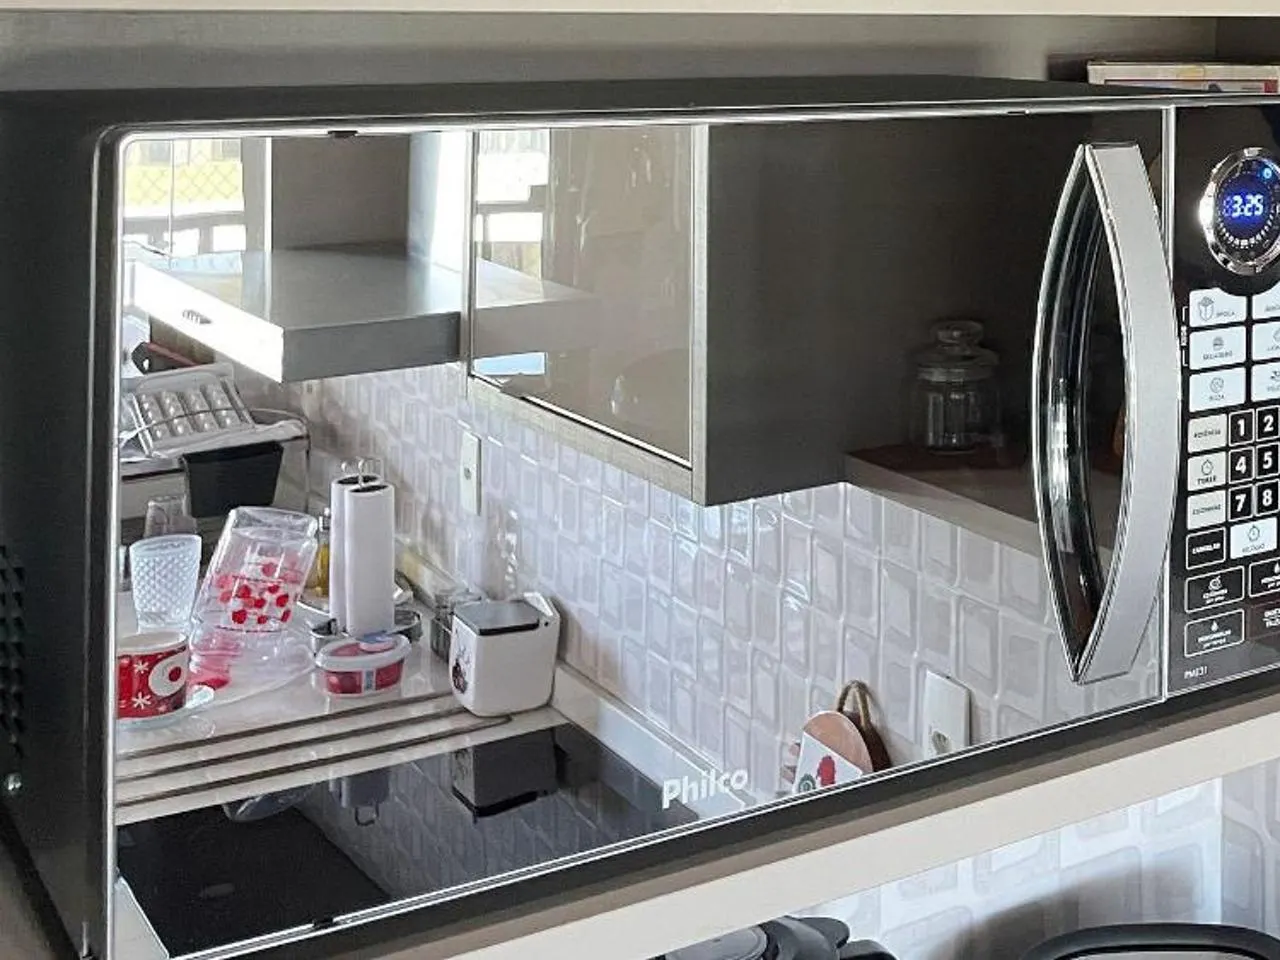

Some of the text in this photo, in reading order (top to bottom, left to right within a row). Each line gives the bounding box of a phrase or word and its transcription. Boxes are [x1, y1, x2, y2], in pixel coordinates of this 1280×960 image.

[1237, 418, 1246, 437] 1
[1263, 414, 1275, 433] 2
[1235, 455, 1248, 474] 4
[1262, 450, 1274, 470] 5
[1235, 493, 1247, 513] 7
[1262, 488, 1273, 507] 8
[662, 768, 748, 810] Philco
